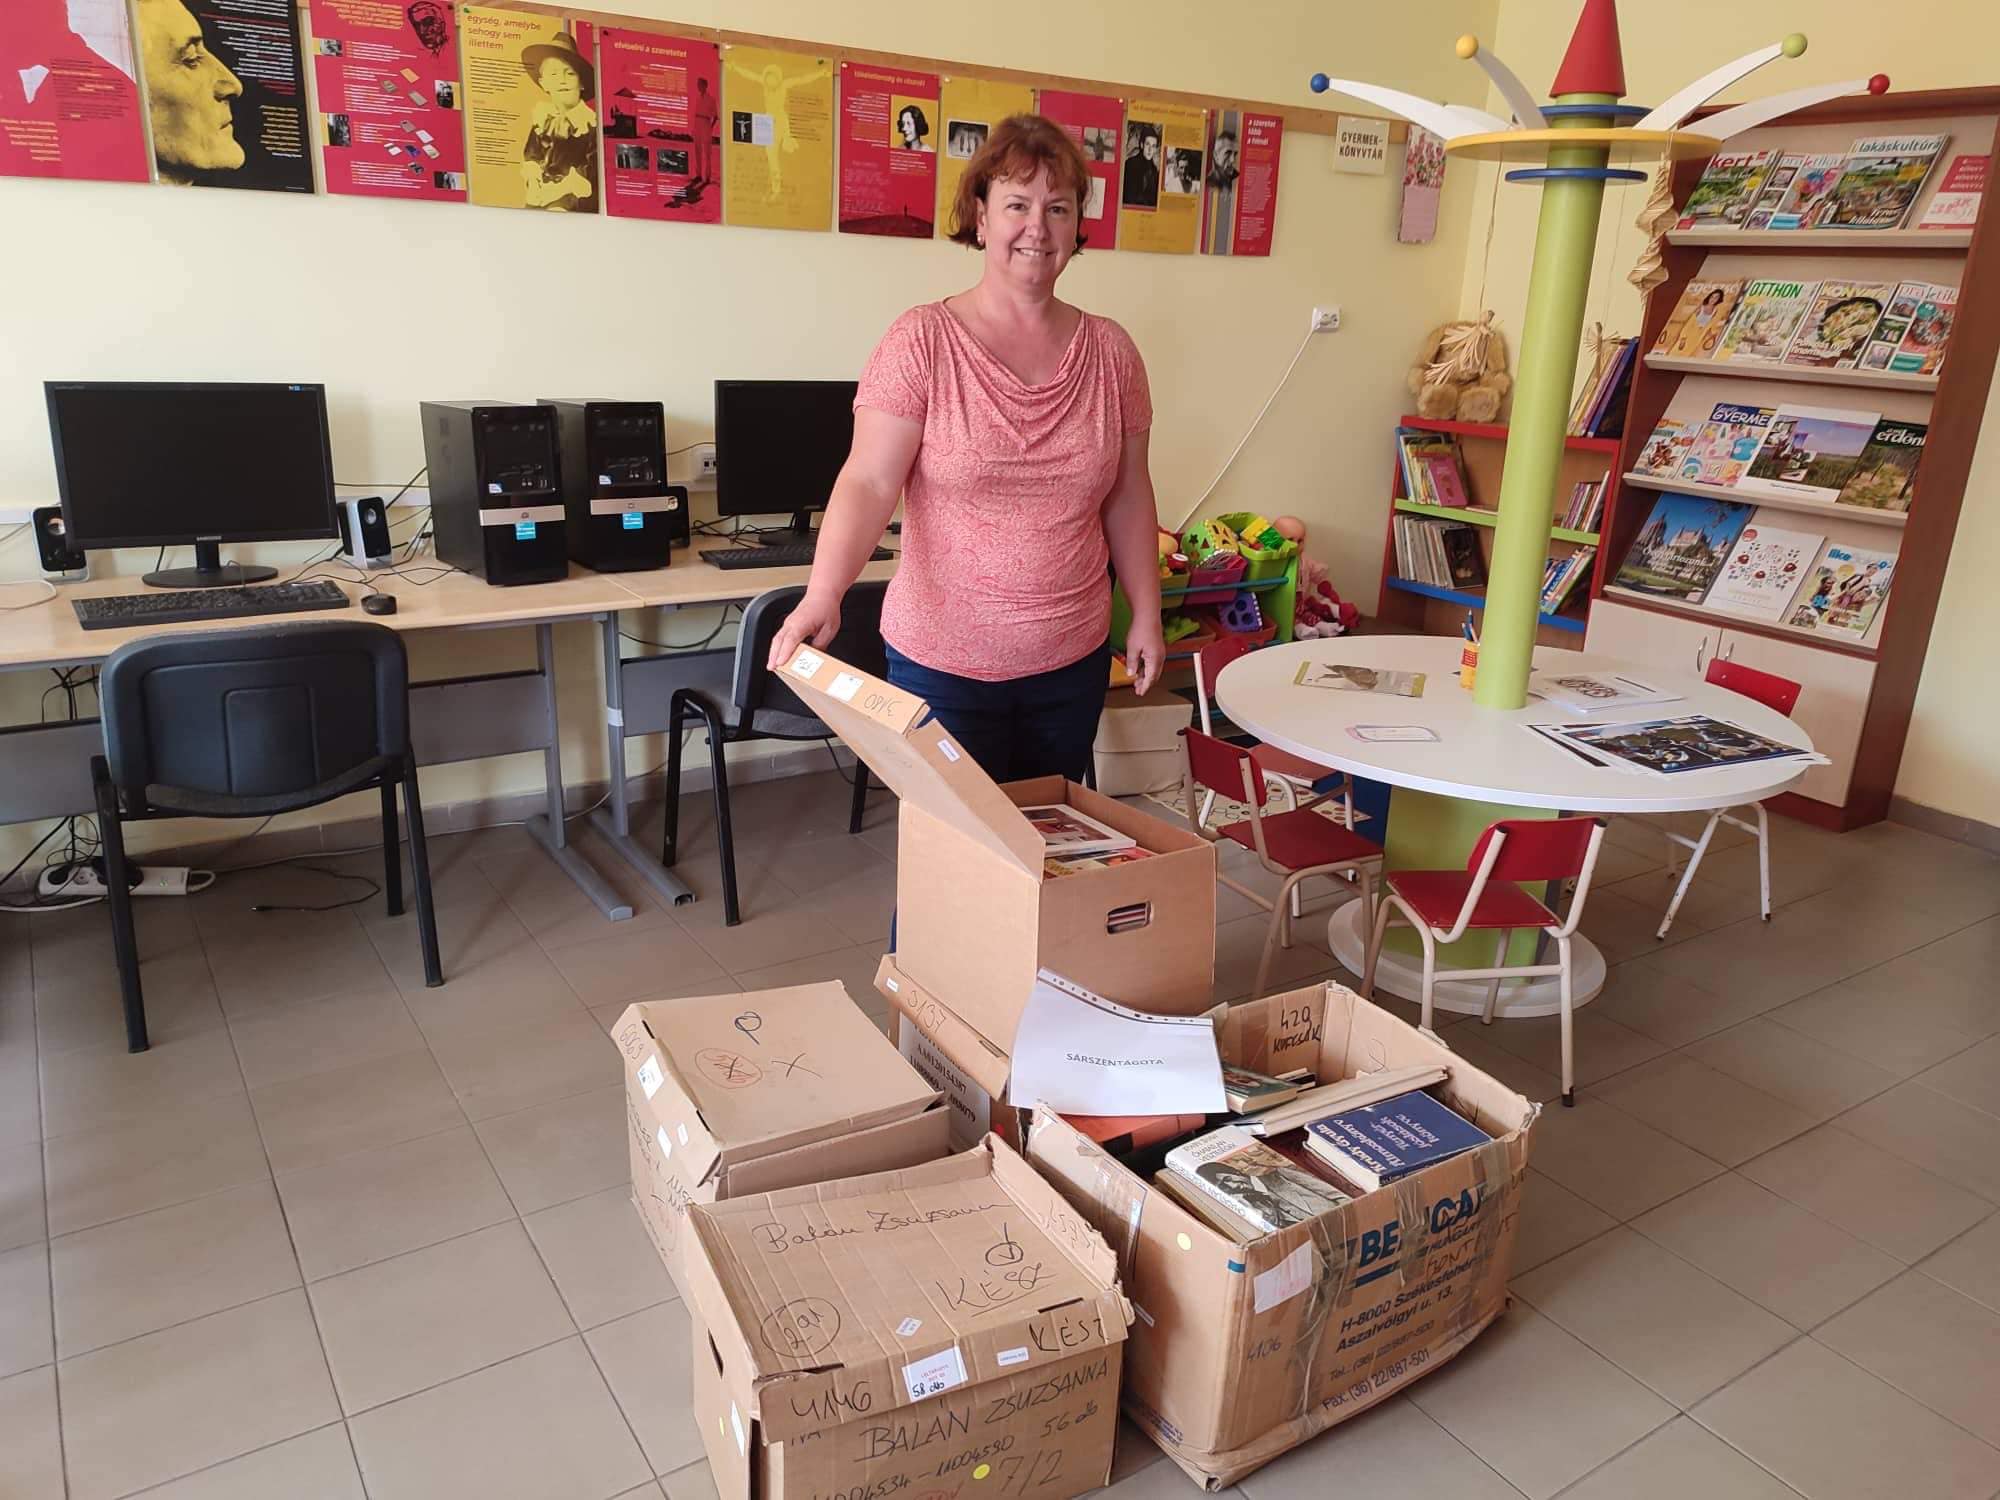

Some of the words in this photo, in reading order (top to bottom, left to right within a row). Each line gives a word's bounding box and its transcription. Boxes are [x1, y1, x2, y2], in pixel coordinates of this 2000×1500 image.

[467, 27, 501, 39] sehogy
[503, 31, 521, 40] sem
[468, 39, 504, 49] illettem
[1341, 131, 1383, 145] GYERMEK-
[1339, 146, 1383, 160] KÖNYVTÁR
[1709, 154, 1754, 168] kert
[1750, 282, 1804, 299] OTTHON
[1712, 411, 1772, 427] GYERME
[1350, 1380, 1373, 1401] (36)
[1372, 1348, 1431, 1388] 22/887-501
[912, 1382, 926, 1398] 58
[984, 1358, 1109, 1424] ZSUZSANNA
